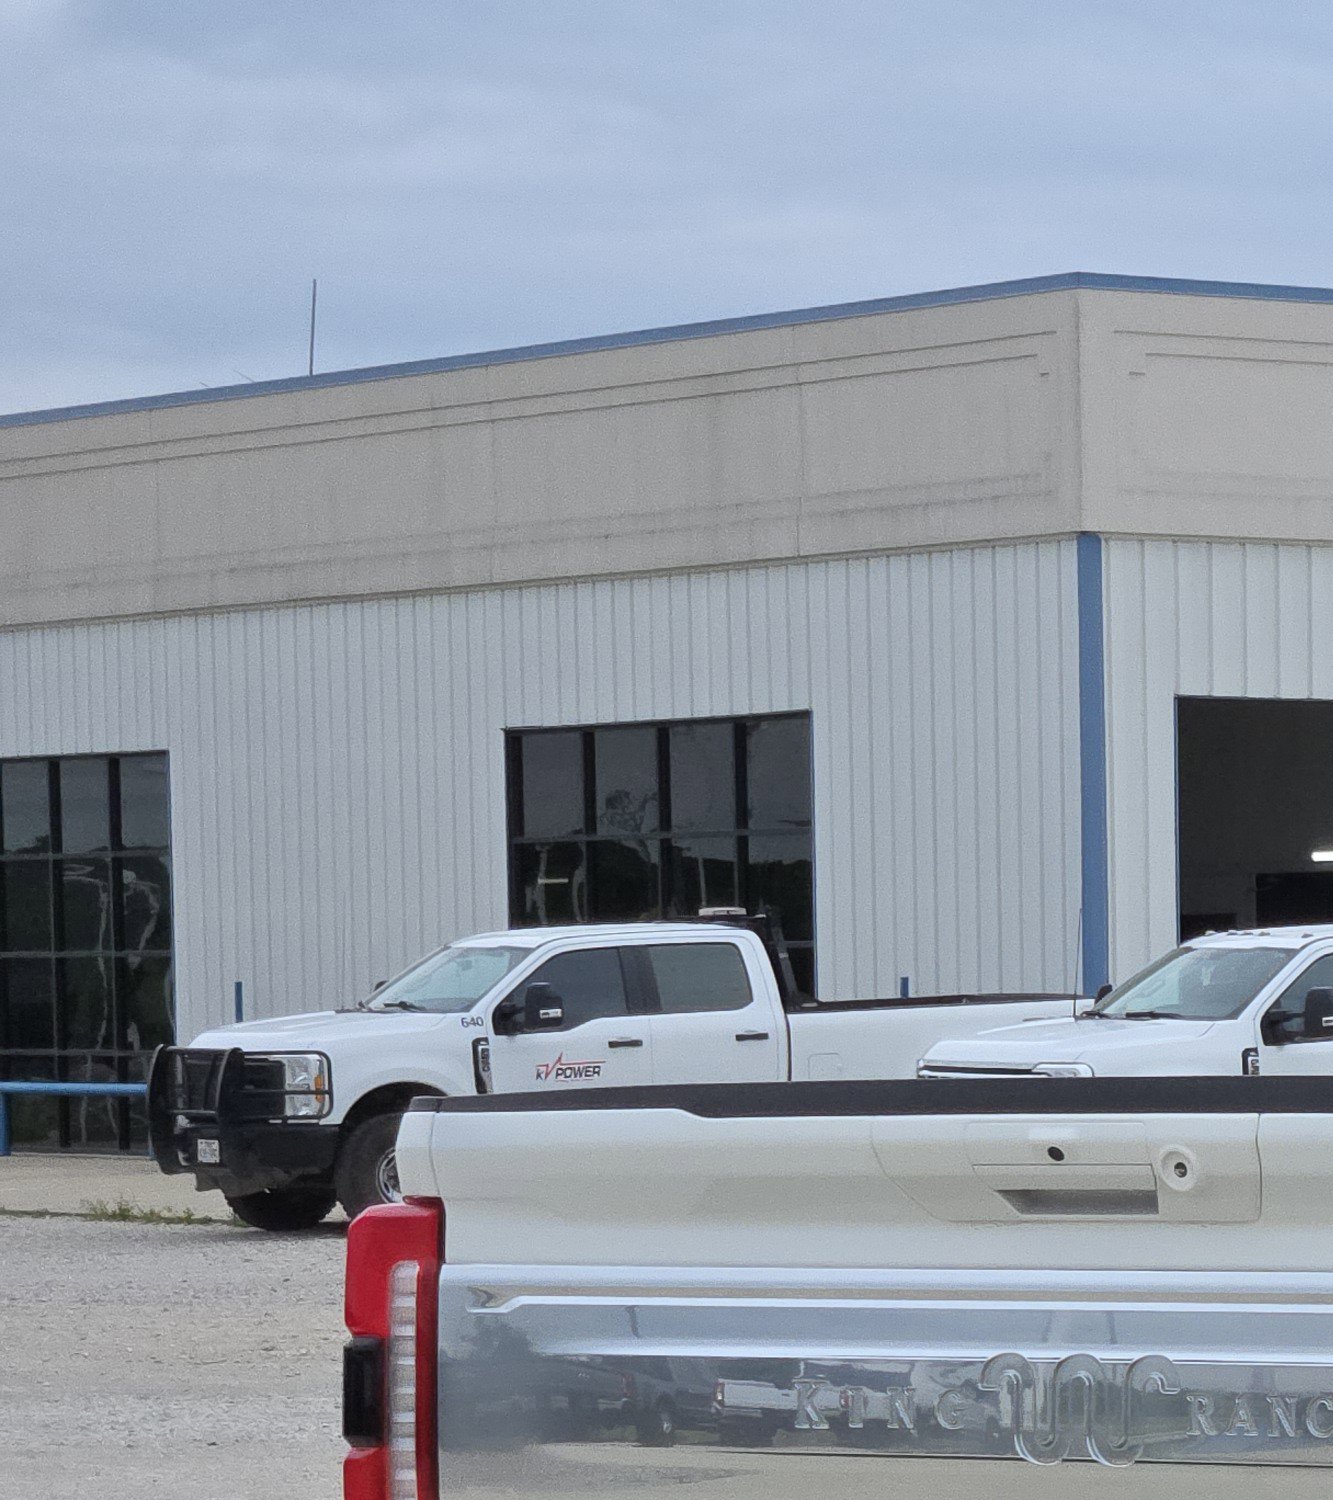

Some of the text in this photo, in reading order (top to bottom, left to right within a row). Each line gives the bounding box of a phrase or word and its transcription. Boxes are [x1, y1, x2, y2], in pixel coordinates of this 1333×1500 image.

[460, 1016, 484, 1028] 640
[555, 1065, 601, 1080] POWER
[792, 1378, 967, 1431] KING
